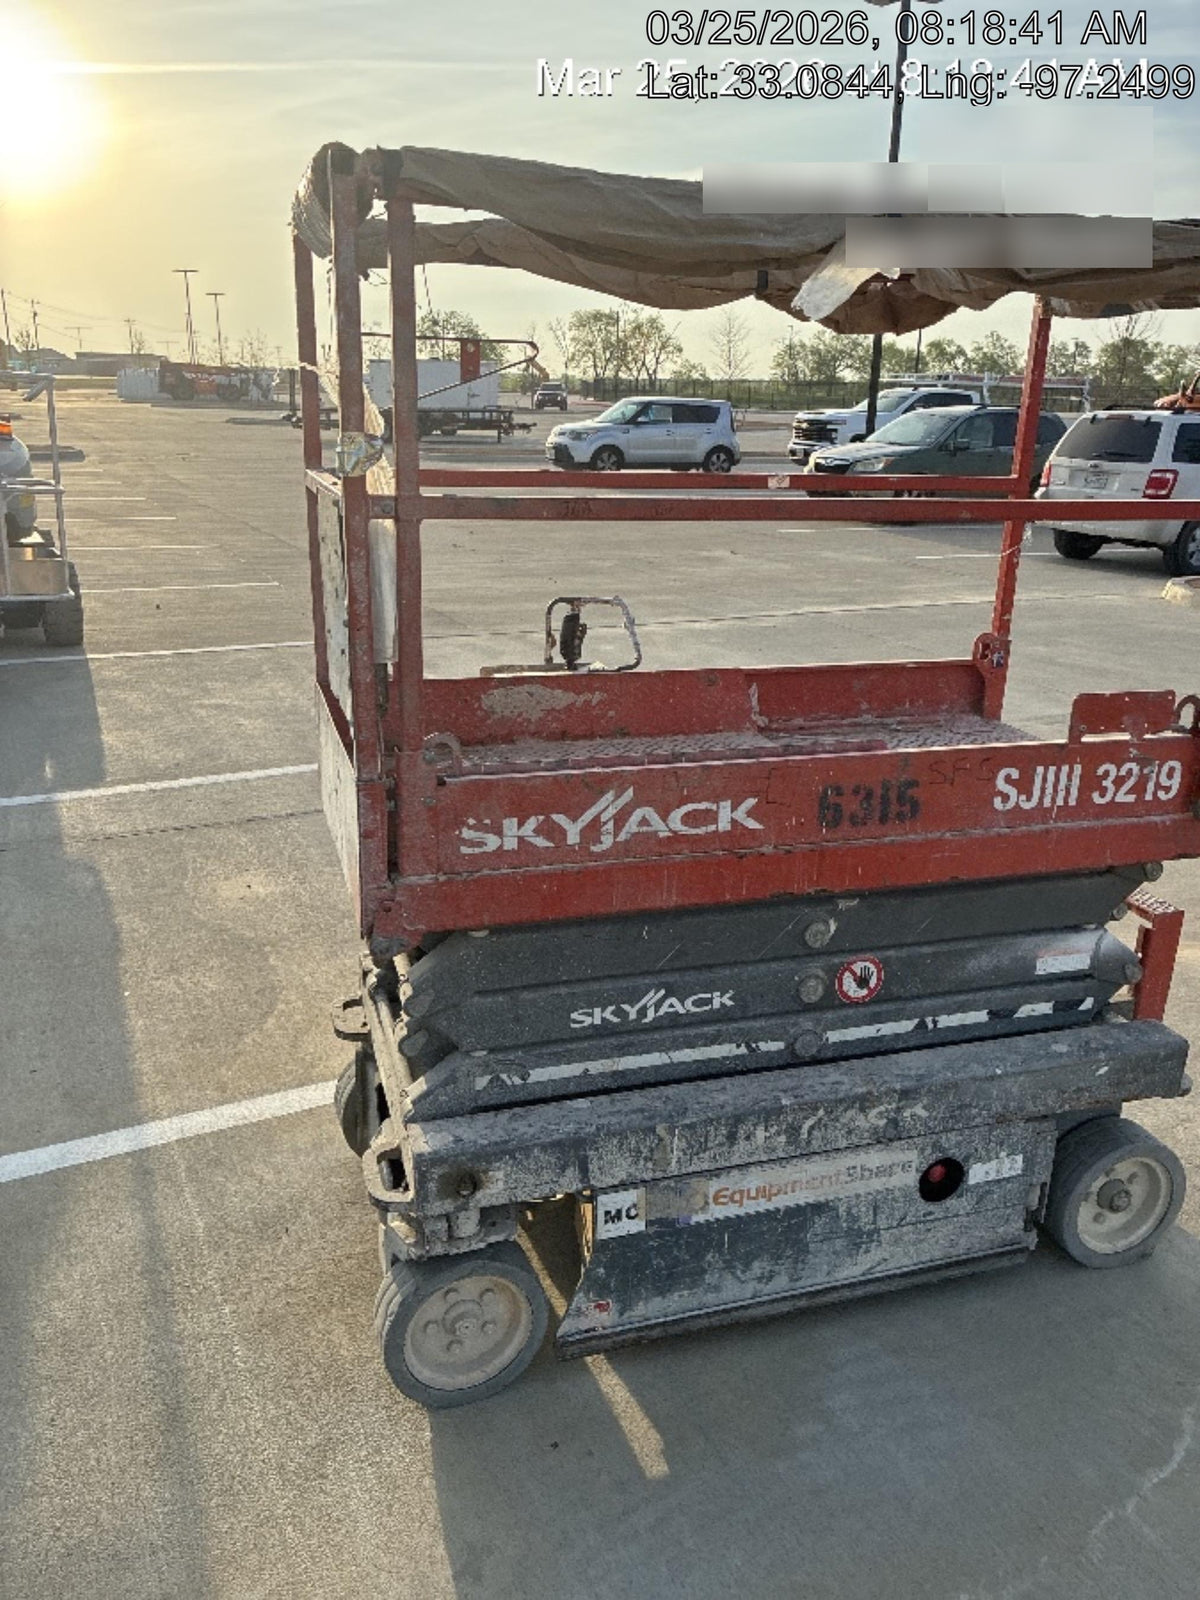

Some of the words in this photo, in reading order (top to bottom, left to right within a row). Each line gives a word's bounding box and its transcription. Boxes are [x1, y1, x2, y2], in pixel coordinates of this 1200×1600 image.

[818, 777, 921, 830] 6315
[1092, 760, 1182, 805] 3219
[458, 786, 765, 854] SKYJACK
[570, 988, 736, 1029] SKYJACK
